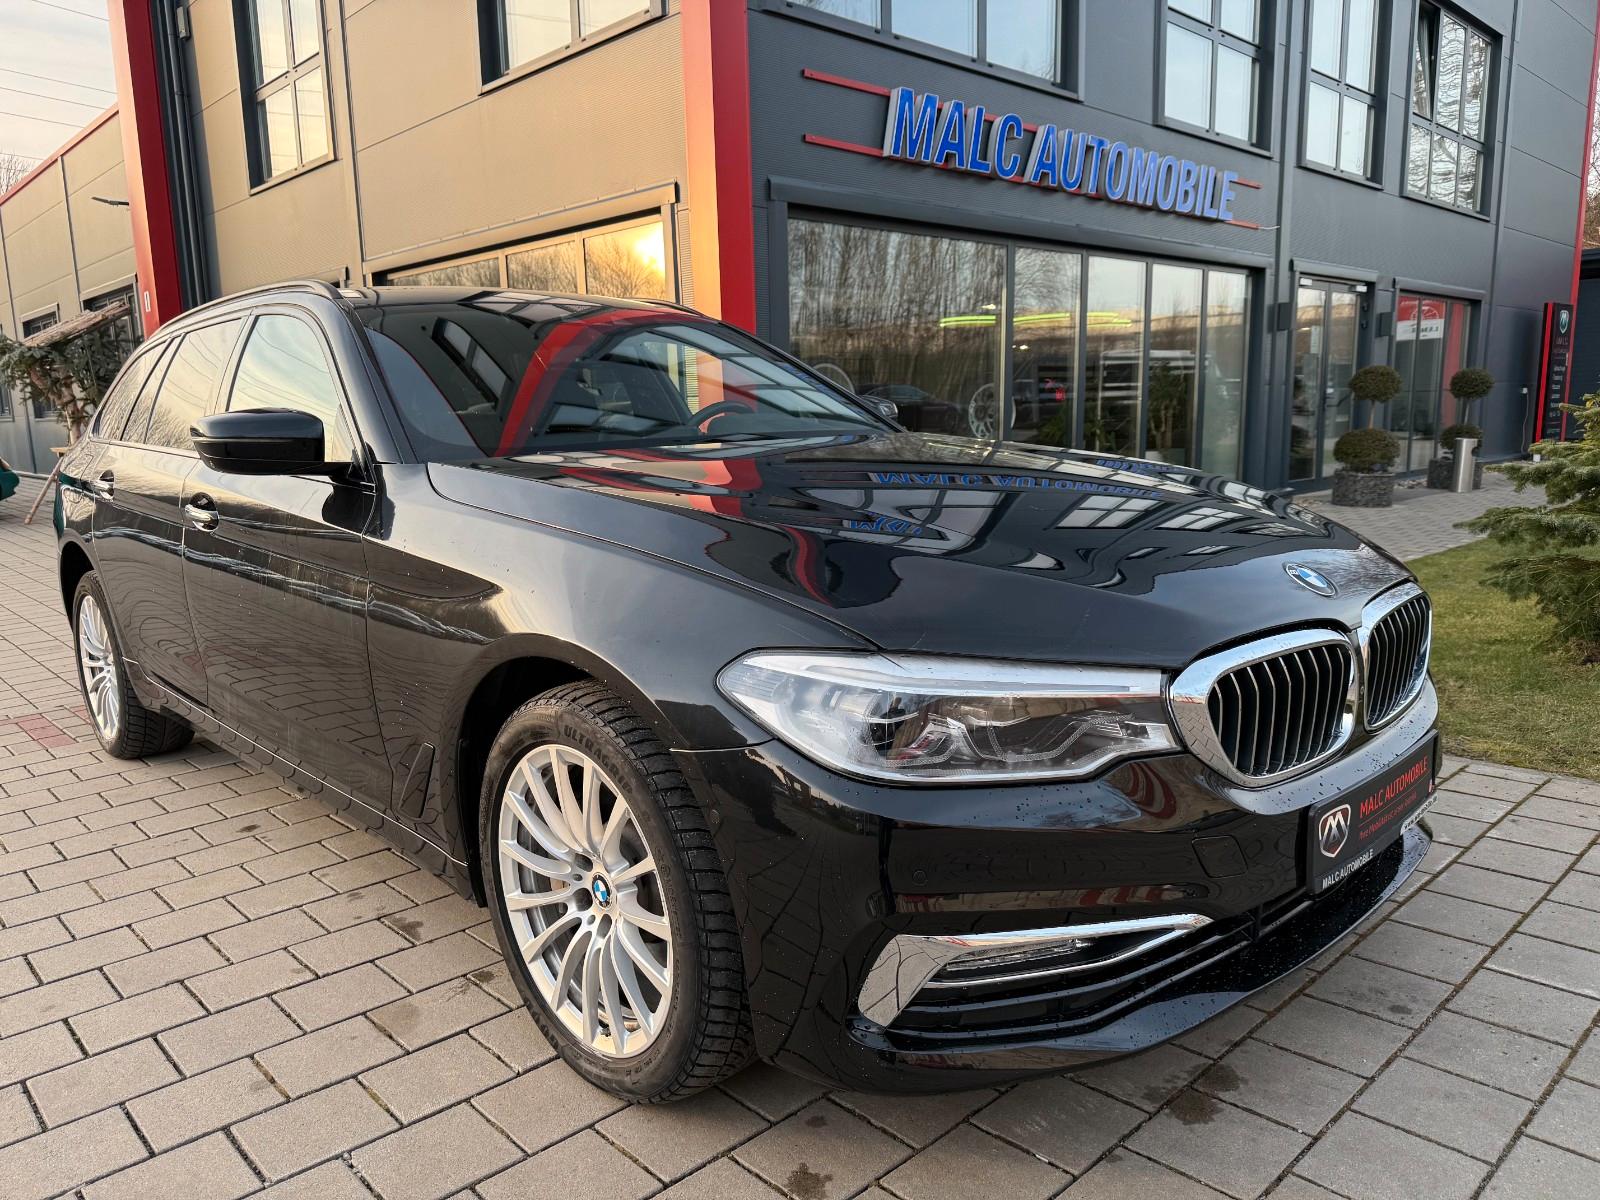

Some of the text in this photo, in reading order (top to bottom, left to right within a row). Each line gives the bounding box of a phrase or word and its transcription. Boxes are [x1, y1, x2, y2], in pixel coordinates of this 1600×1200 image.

[885, 86, 1239, 221] MALC AUTOMOBILE
[1360, 788, 1384, 818] MALC
[1385, 756, 1429, 802] AUTOMOBILE
[1322, 849, 1374, 889] MALC AUTOMOBILE
